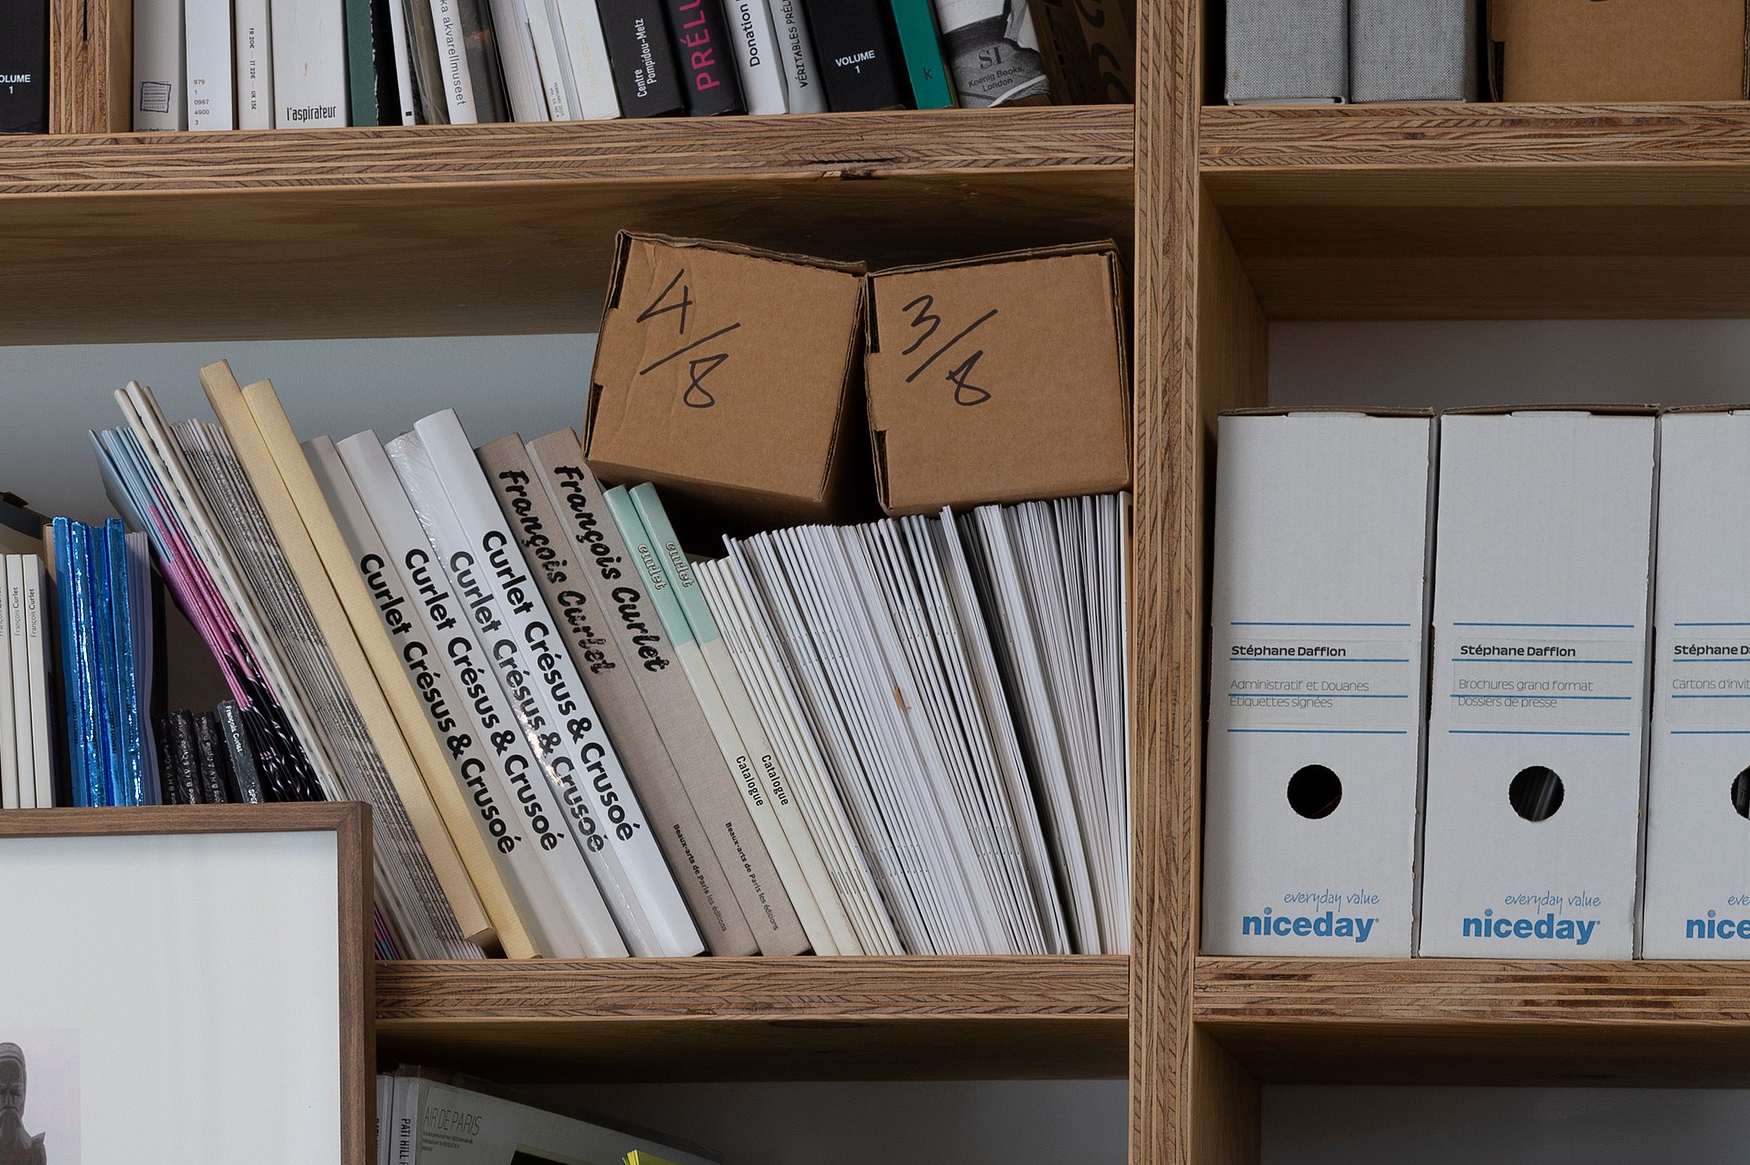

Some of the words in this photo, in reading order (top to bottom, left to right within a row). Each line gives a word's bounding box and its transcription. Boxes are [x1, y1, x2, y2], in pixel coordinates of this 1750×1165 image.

[634, 18, 657, 84] Pompidou-Metz
[740, 3, 761, 67] Donation
[444, 17, 466, 106] akvarellmuseet
[790, 26, 808, 88] VÉRITABLES
[634, 69, 647, 98] Centre
[968, 70, 995, 88] Koenig
[996, 66, 1025, 78] Books,
[982, 77, 1014, 92] London
[286, 105, 337, 122] l'aspirateur
[554, 465, 621, 581] François
[612, 587, 669, 673] Curlet
[1232, 645, 1295, 657] Stéphane
[1298, 646, 1346, 656] Dafflon
[482, 530, 534, 614] Curlet
[524, 621, 576, 713] Crésus
[567, 717, 593, 742] &
[580, 743, 634, 842] Crusoé
[736, 756, 764, 807] Catalogue
[1284, 889, 1341, 912] everyday
[1347, 889, 1379, 905] value
[1242, 907, 1374, 942] niceday
[401, 1118, 410, 1140] PATI
[401, 1142, 410, 1160] HILL
